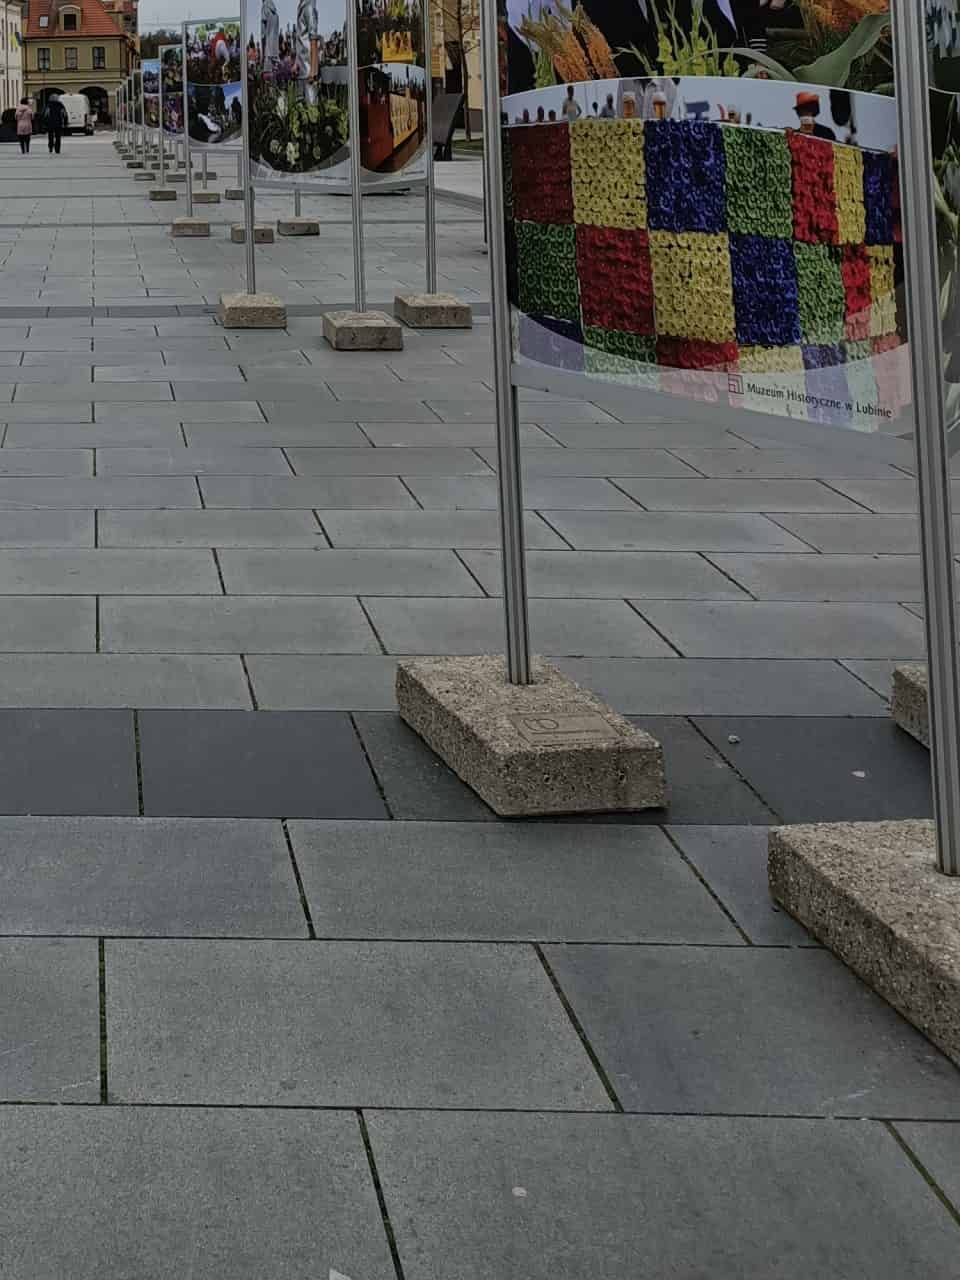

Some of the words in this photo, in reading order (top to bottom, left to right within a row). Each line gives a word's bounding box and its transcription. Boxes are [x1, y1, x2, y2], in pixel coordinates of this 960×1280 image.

[747, 383, 784, 400] Muzeum
[787, 390, 841, 409] Historyczne
[845, 401, 853, 411] w
[856, 402, 892, 418] Lubinie
